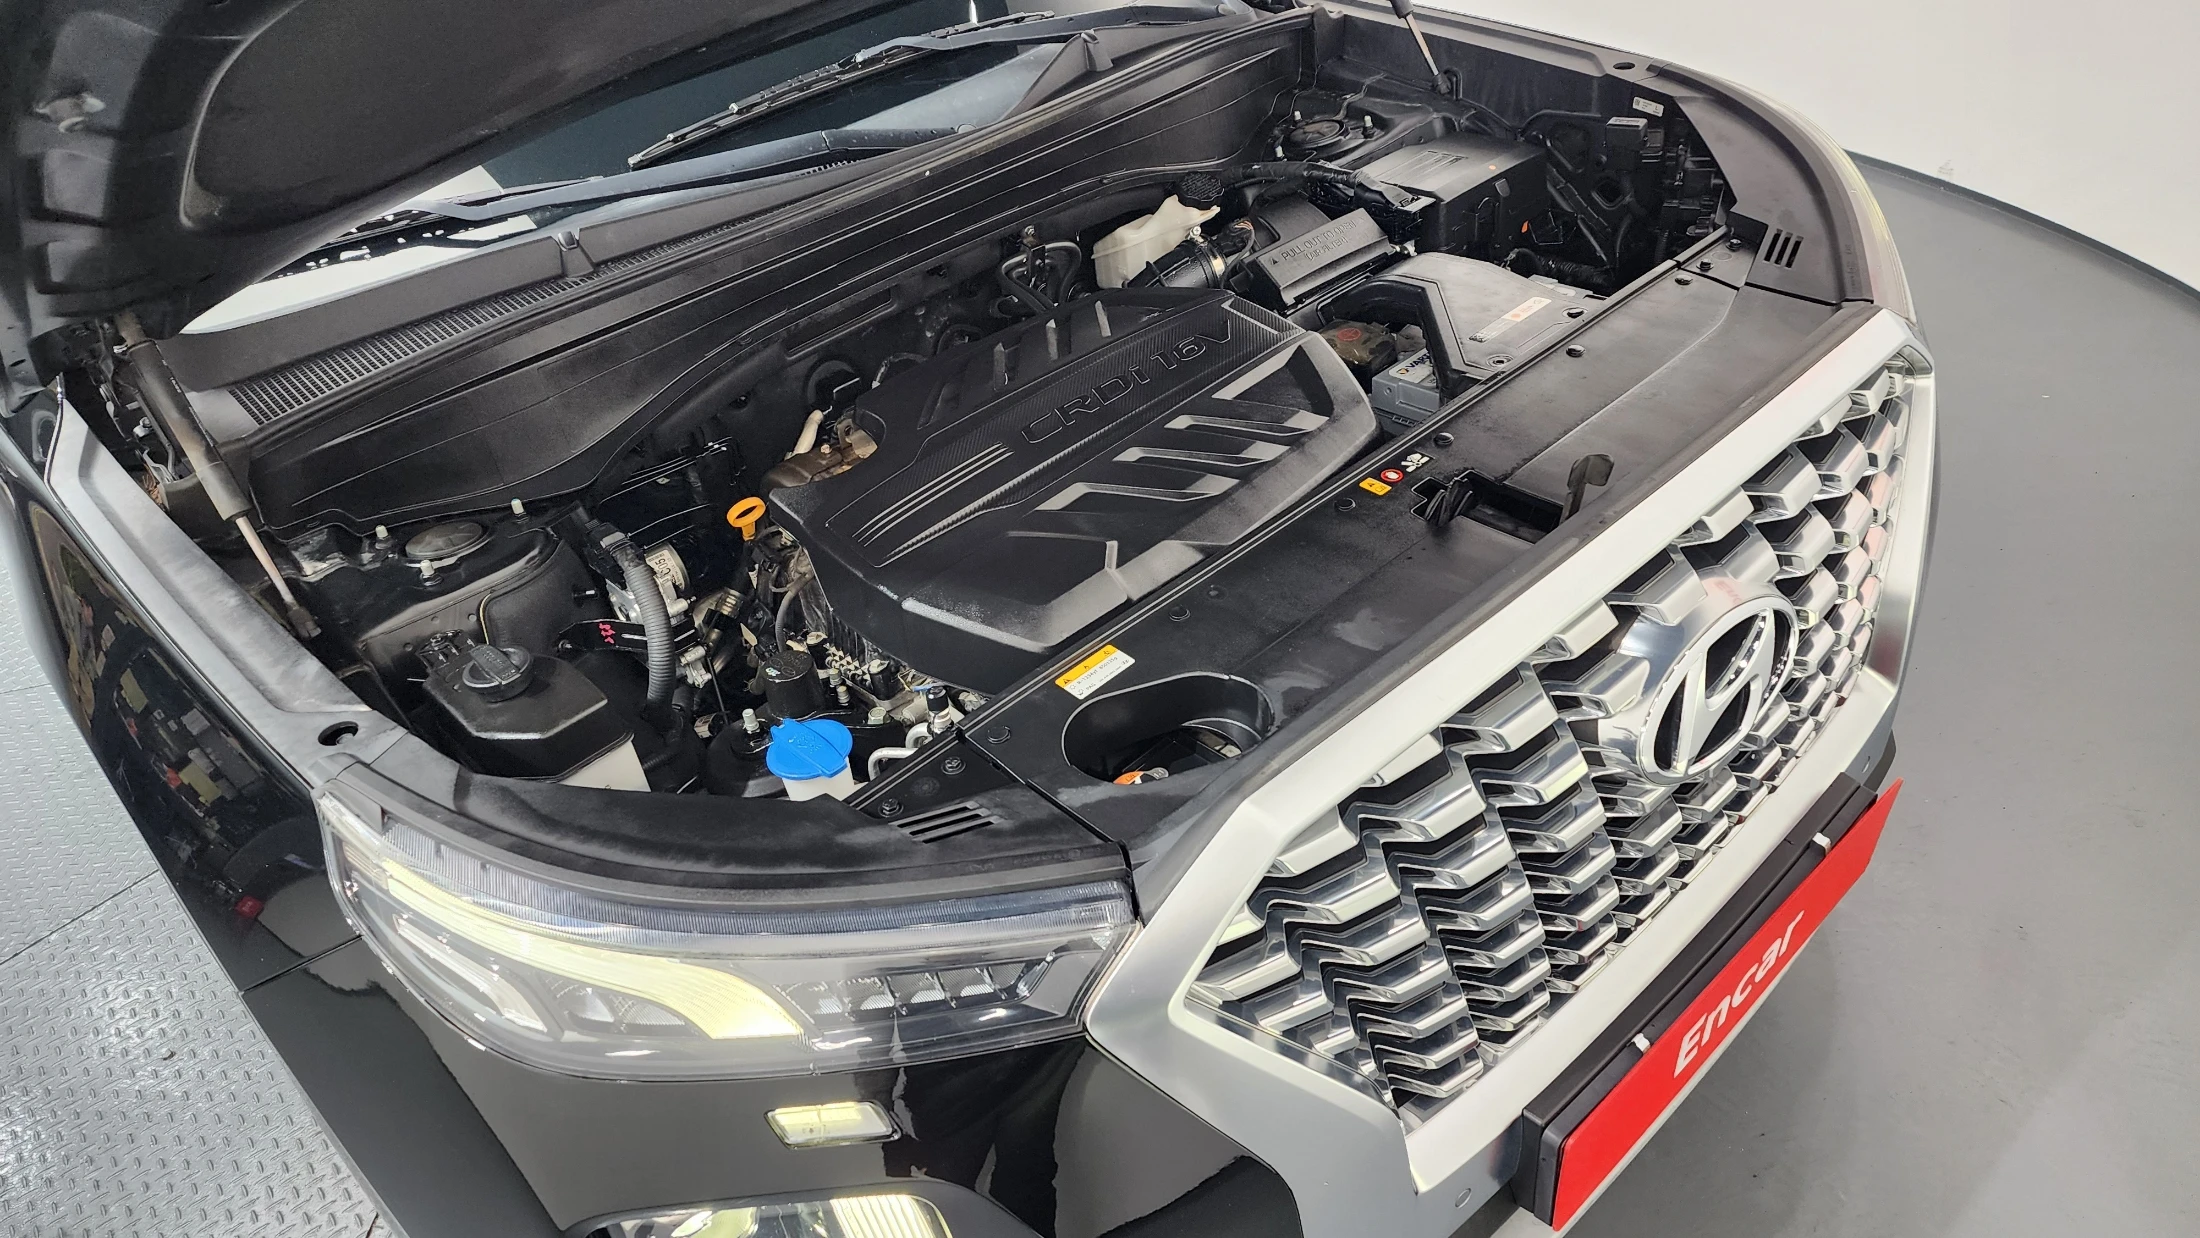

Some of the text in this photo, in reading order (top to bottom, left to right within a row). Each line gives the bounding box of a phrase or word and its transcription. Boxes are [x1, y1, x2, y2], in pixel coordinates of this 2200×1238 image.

[1281, 219, 1357, 261] PULL OUT TO OPEN
[1150, 318, 1231, 370] 16V
[1405, 352, 1430, 368] VART
[1674, 909, 1805, 1079] Encar
